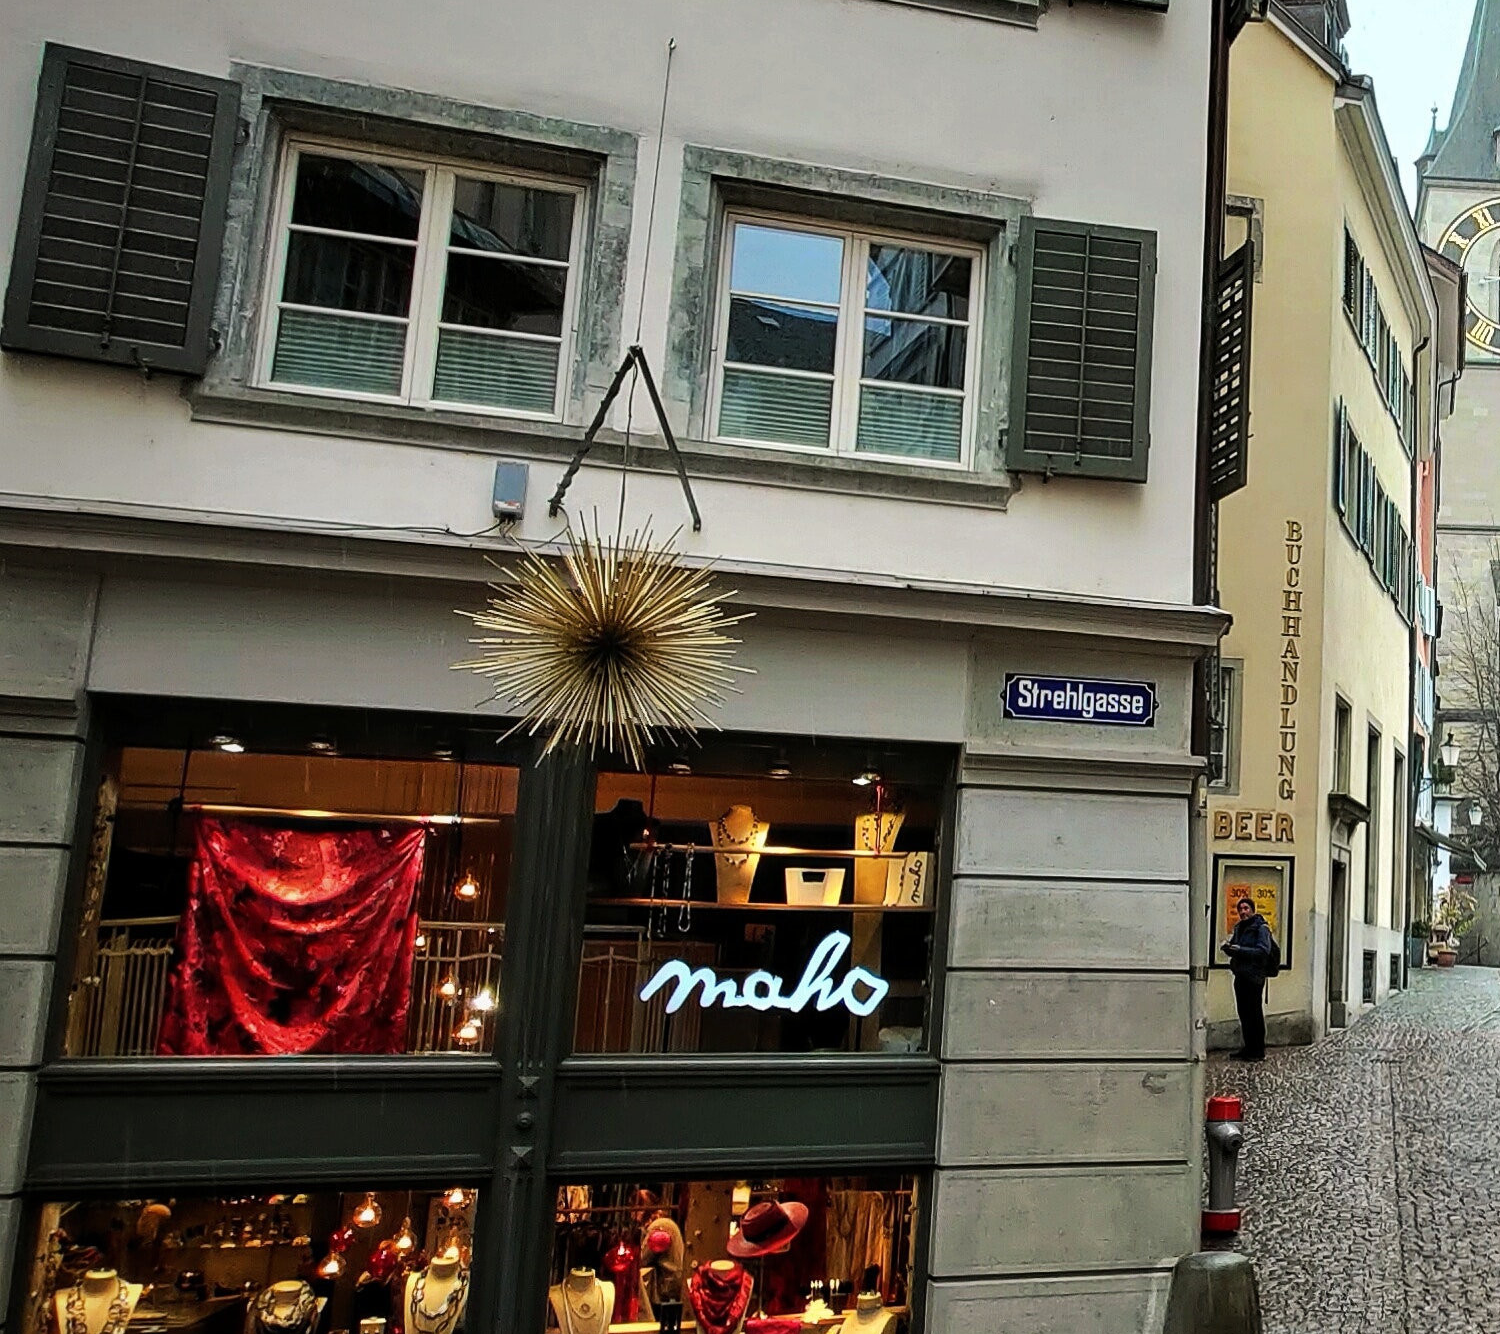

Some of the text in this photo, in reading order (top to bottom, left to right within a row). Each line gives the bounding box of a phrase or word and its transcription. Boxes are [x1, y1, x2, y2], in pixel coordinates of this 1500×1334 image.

[1472, 208, 1494, 229] XI
[1449, 232, 1469, 248] X
[1278, 521, 1303, 801] BUCHHANDLUNG
[1018, 680, 1144, 718] Strehlgasse
[1214, 811, 1295, 843] BEER
[1230, 888, 1249, 898] 30%
[1257, 888, 1276, 898] 30%
[640, 930, 889, 1016] maho
